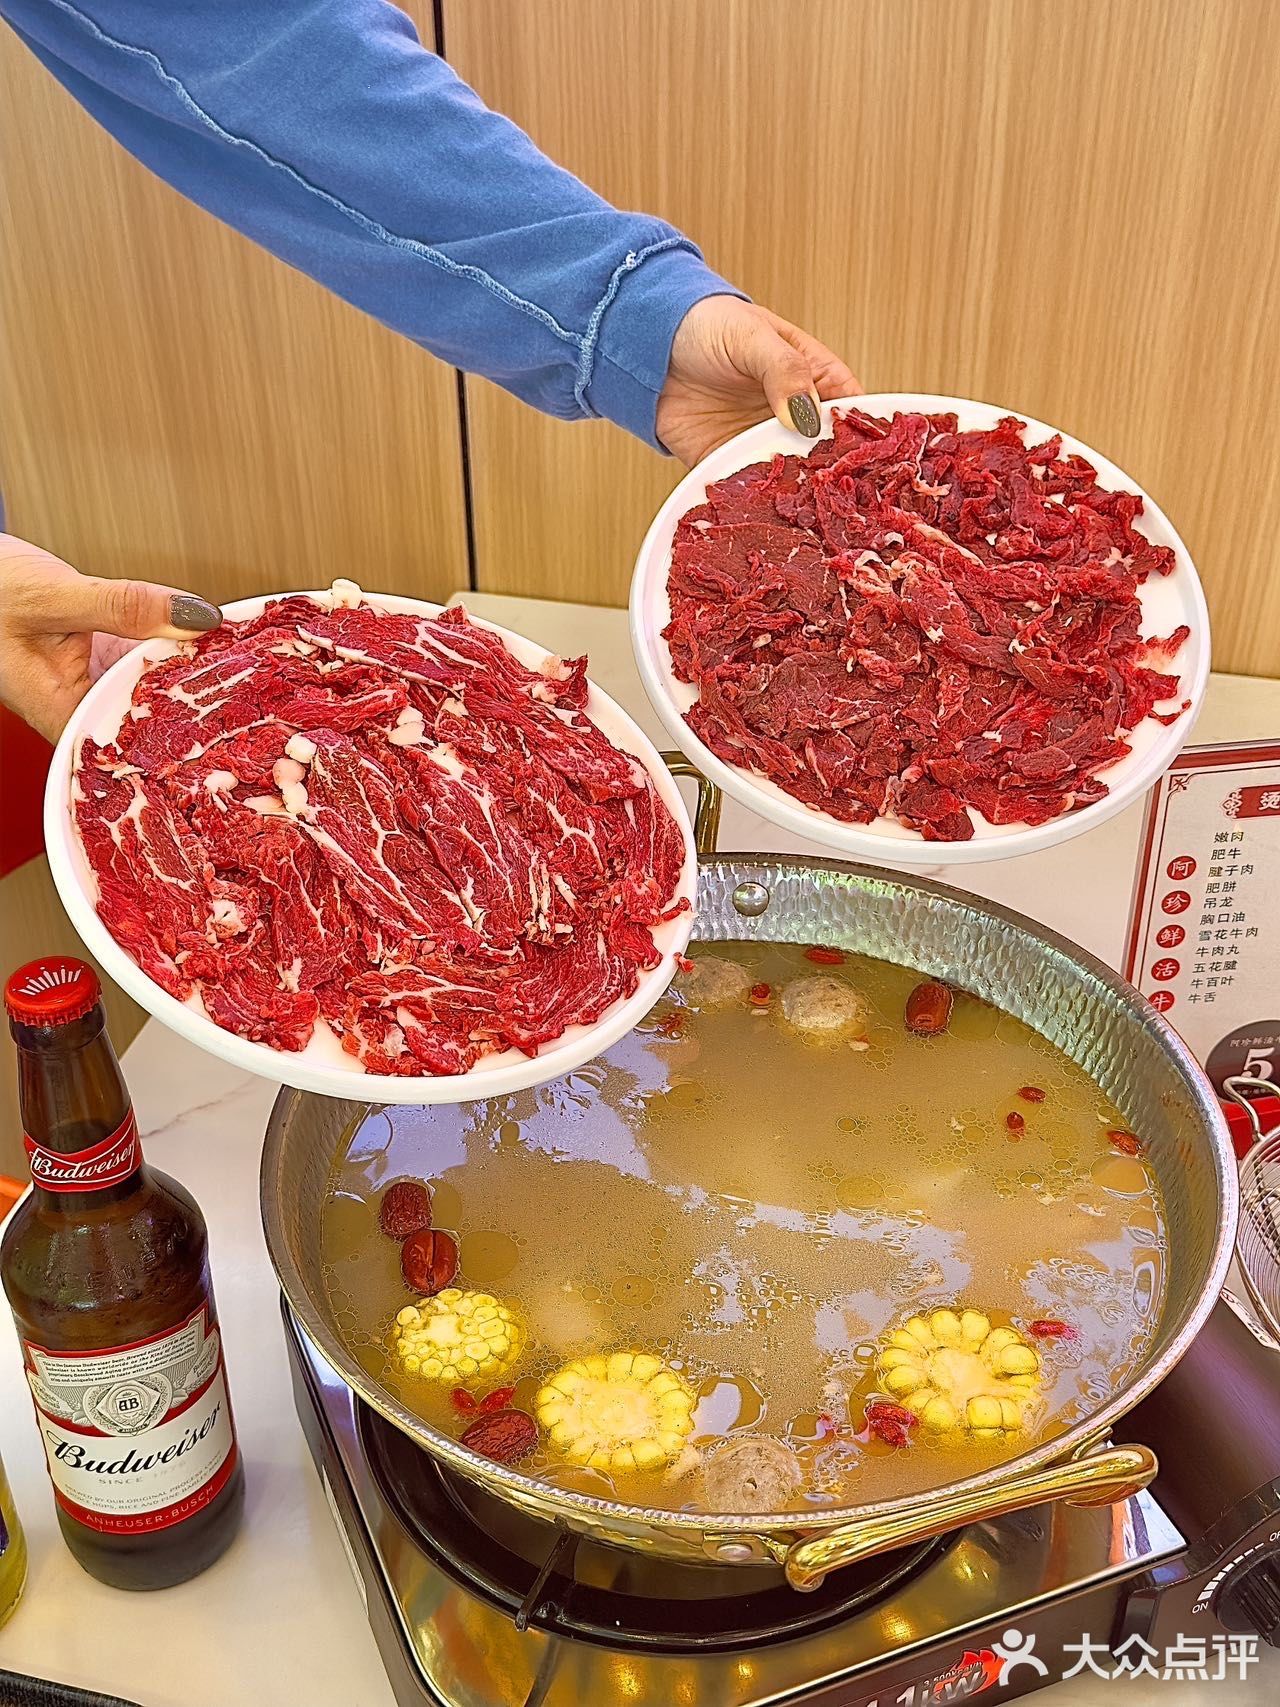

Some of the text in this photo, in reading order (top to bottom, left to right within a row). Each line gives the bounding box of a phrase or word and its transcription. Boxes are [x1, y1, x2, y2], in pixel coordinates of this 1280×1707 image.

[1213, 831, 1244, 843] 嫩肉
[1211, 847, 1242, 860] 肥牛
[1207, 863, 1254, 878] 腱子肉
[1205, 881, 1237, 894] 肥胼
[1203, 896, 1234, 909] 吊龙
[1200, 912, 1246, 926] 胸口油
[1198, 926, 1259, 942] 雪花牛肉
[1195, 944, 1240, 958] 牛肉丸
[1192, 960, 1238, 974] 五花腱
[1190, 976, 1235, 989] 牛百叶
[1187, 991, 1217, 1005] 牛舌
[31, 1144, 135, 1177] Budweiser
[46, 1400, 221, 1475] Budweiser
[98, 1477, 144, 1485] SINCE
[86, 1485, 215, 1528] ANHEUSER-BUSCH
[1192, 1601, 1209, 1614] ON
